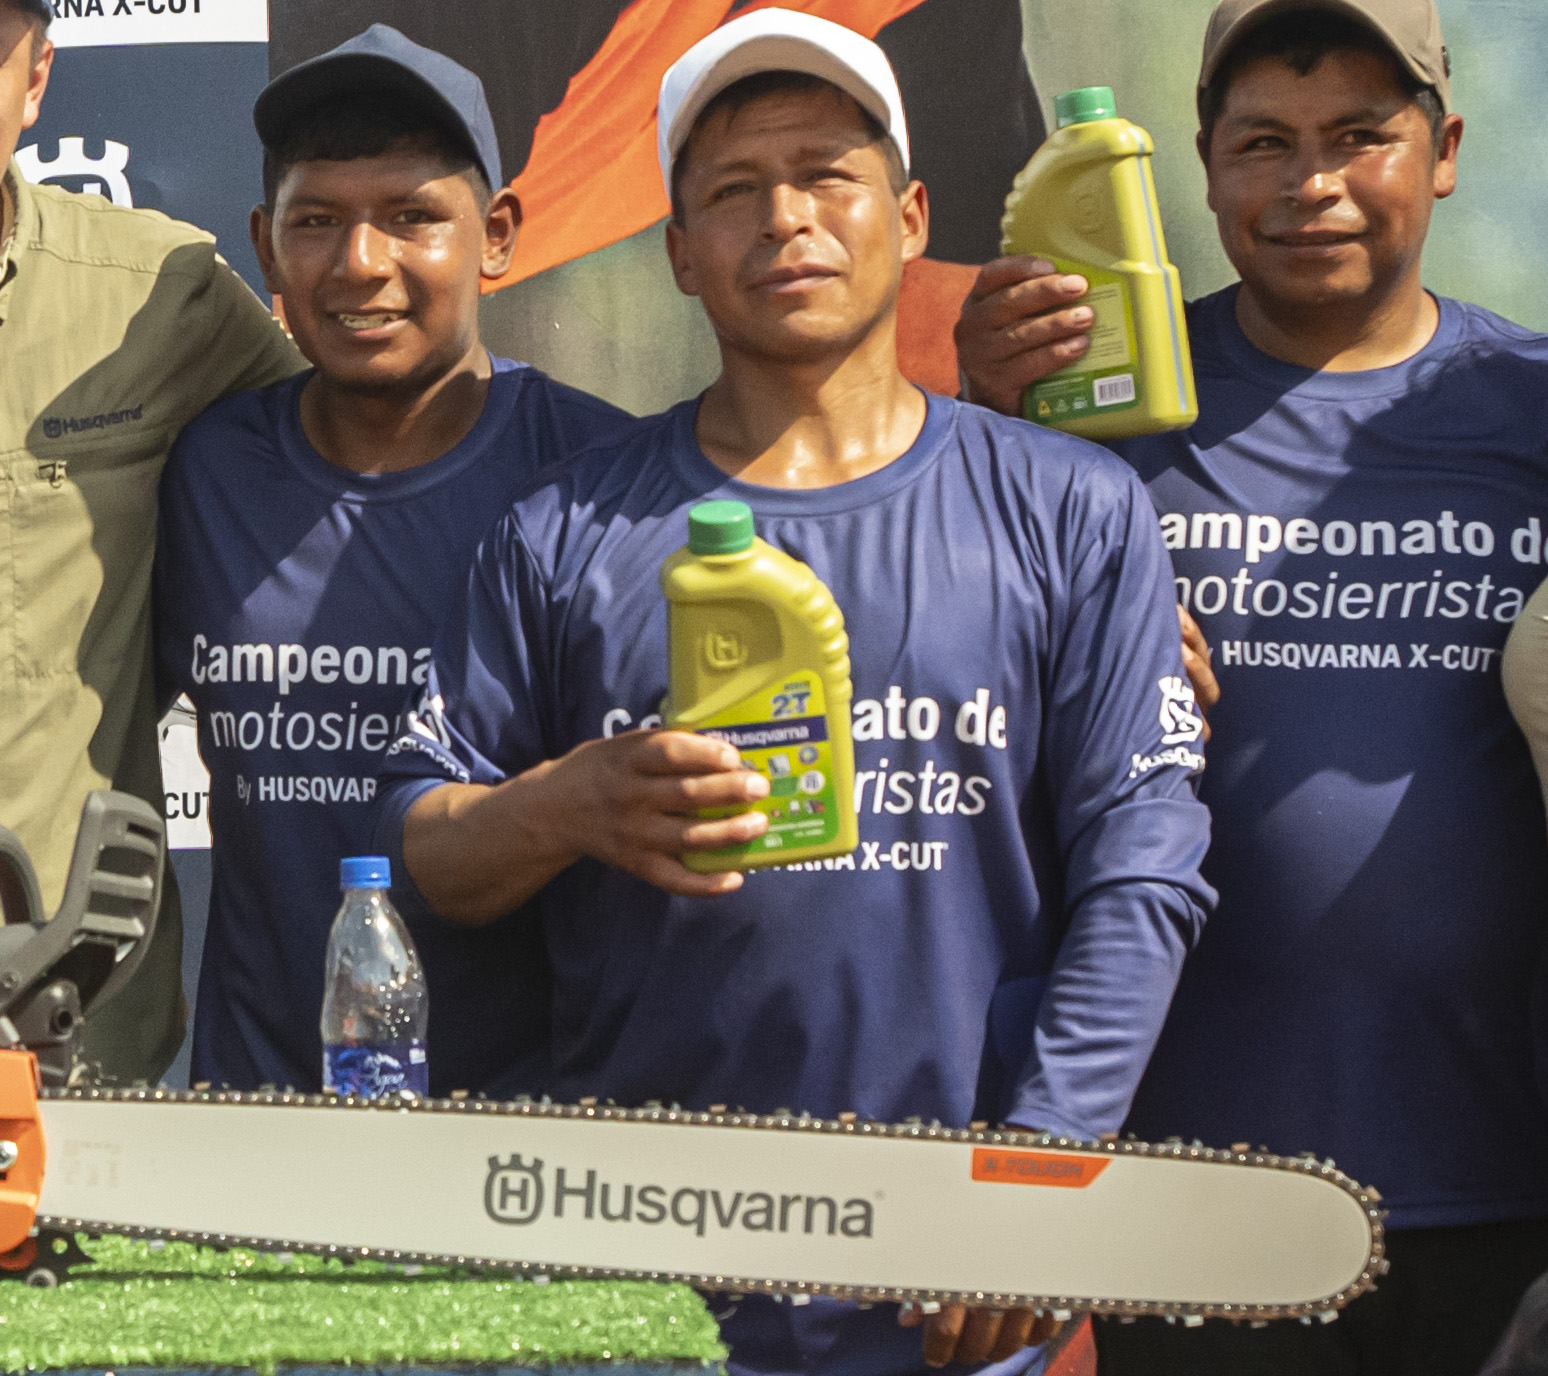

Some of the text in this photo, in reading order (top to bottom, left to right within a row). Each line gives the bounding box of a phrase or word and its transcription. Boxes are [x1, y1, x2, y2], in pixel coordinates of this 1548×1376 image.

[1160, 510, 1494, 564] ampeonato
[1221, 640, 1402, 672] HUSQVARNA
[956, 687, 1008, 750] de
[555, 1167, 875, 1241] Husqvarna
